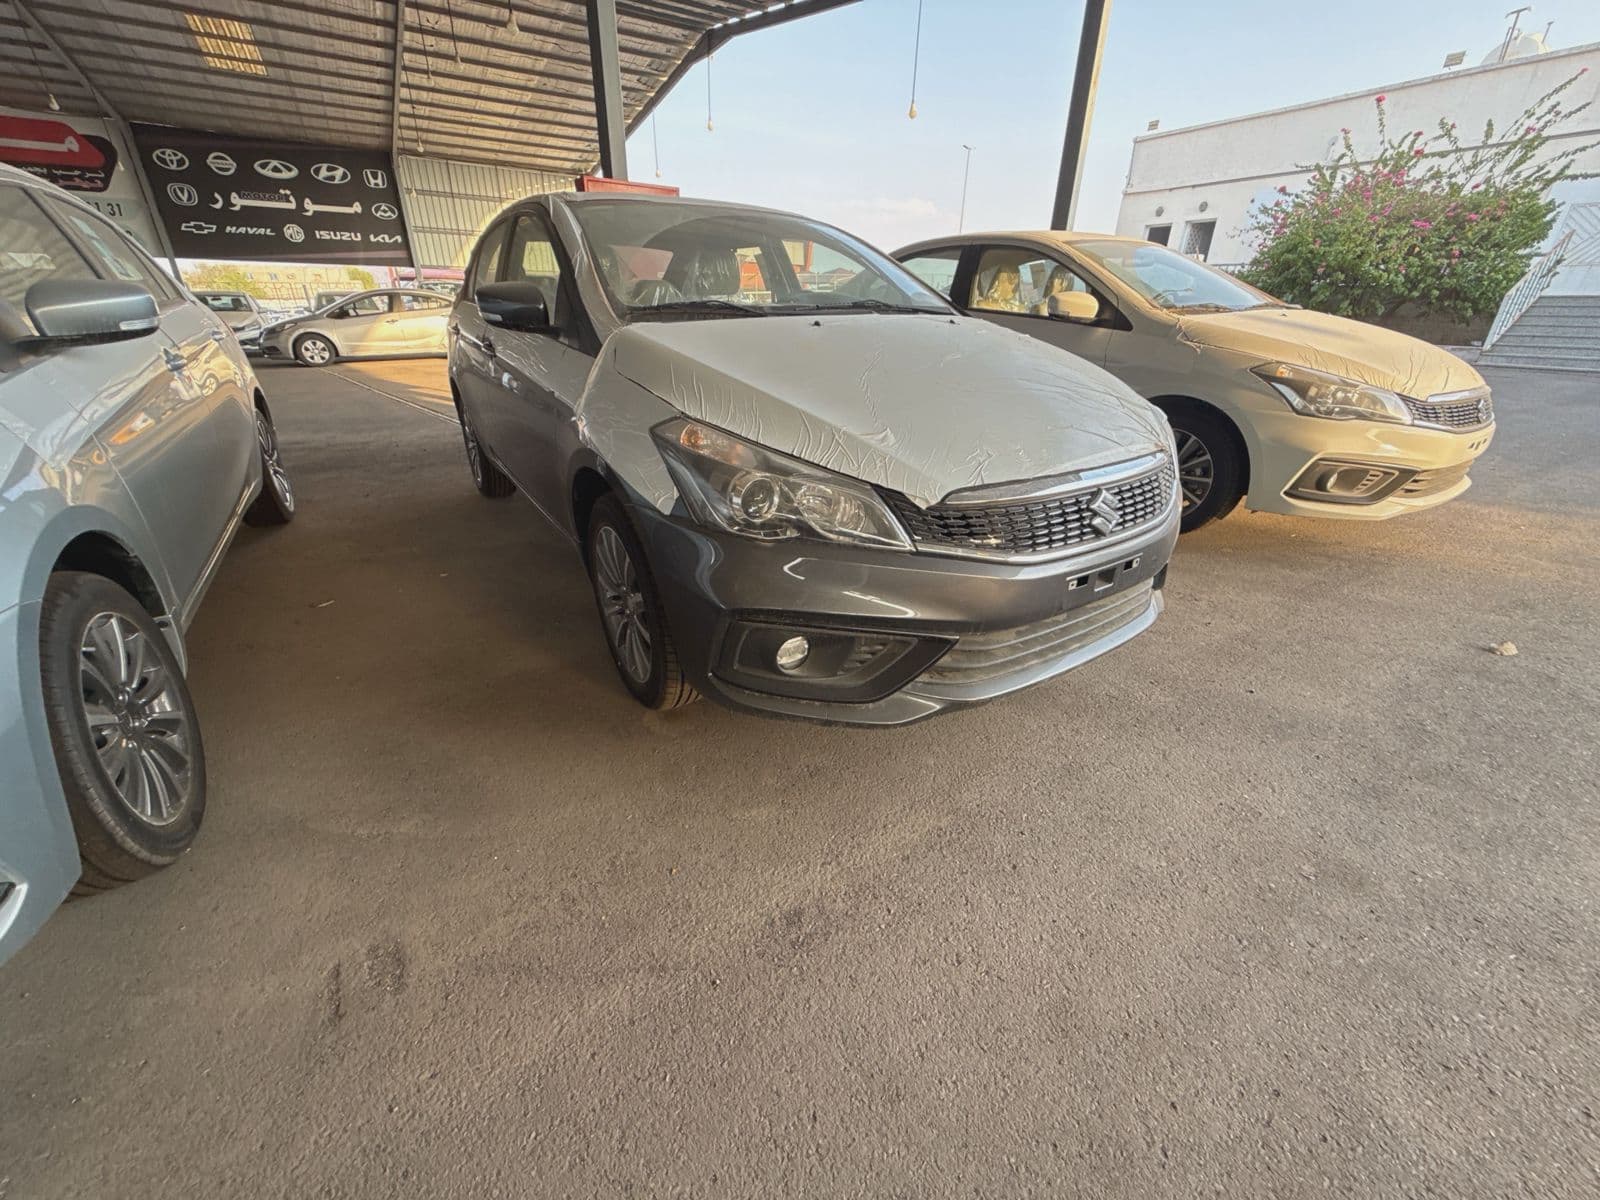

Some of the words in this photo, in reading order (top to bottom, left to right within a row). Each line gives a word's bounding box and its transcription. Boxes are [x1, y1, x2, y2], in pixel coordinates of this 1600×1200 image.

[107, 202, 123, 217] 31
[225, 225, 276, 236] HAVAL
[285, 225, 303, 241] MG
[314, 230, 362, 241] ISUZU
